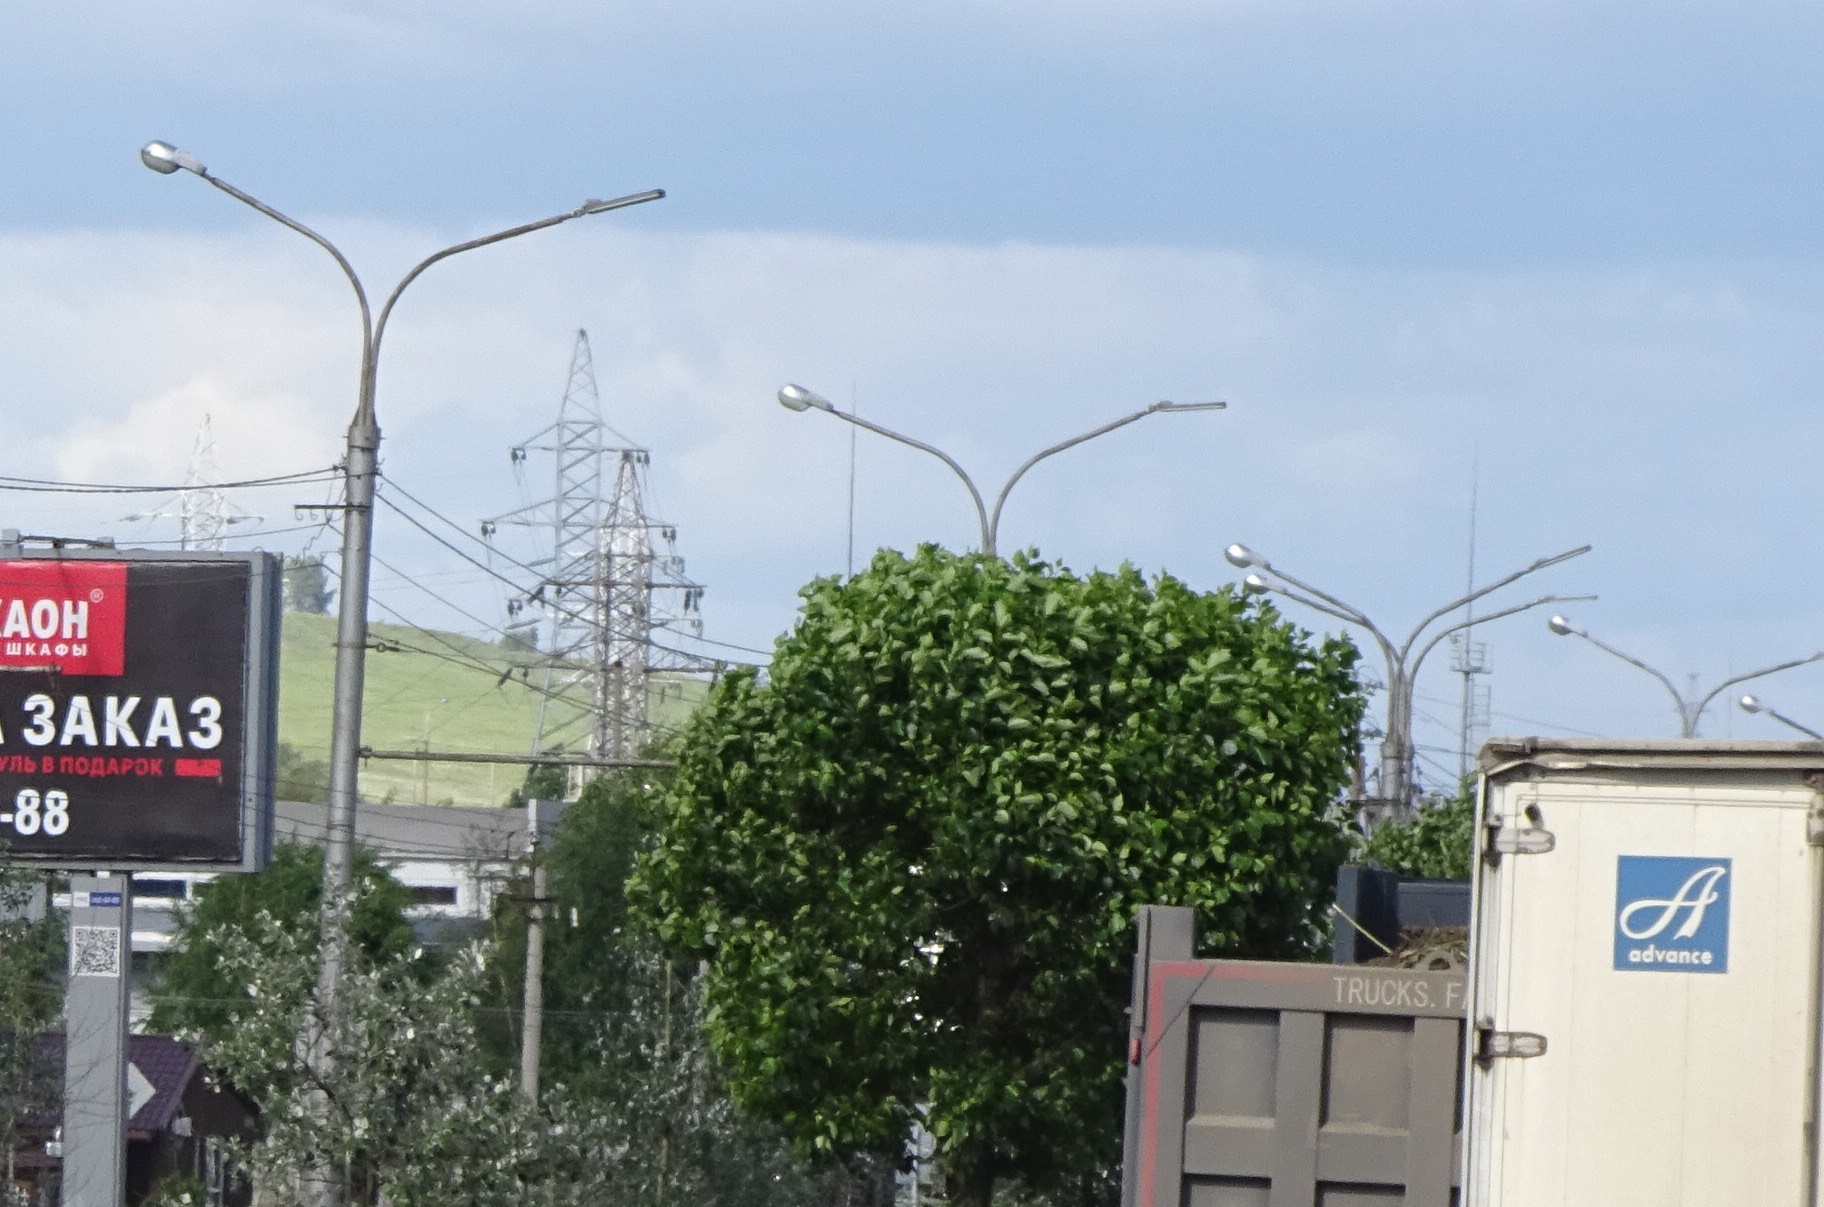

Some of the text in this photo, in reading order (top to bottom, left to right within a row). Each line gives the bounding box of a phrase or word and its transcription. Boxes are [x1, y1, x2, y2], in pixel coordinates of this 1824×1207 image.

[6, 643, 87, 657] ШКАФЫ
[23, 695, 222, 750] ЗАКАЗ
[42, 756, 55, 774] В
[59, 756, 163, 777] ПОДАРОК
[1629, 943, 1713, 965] advance
